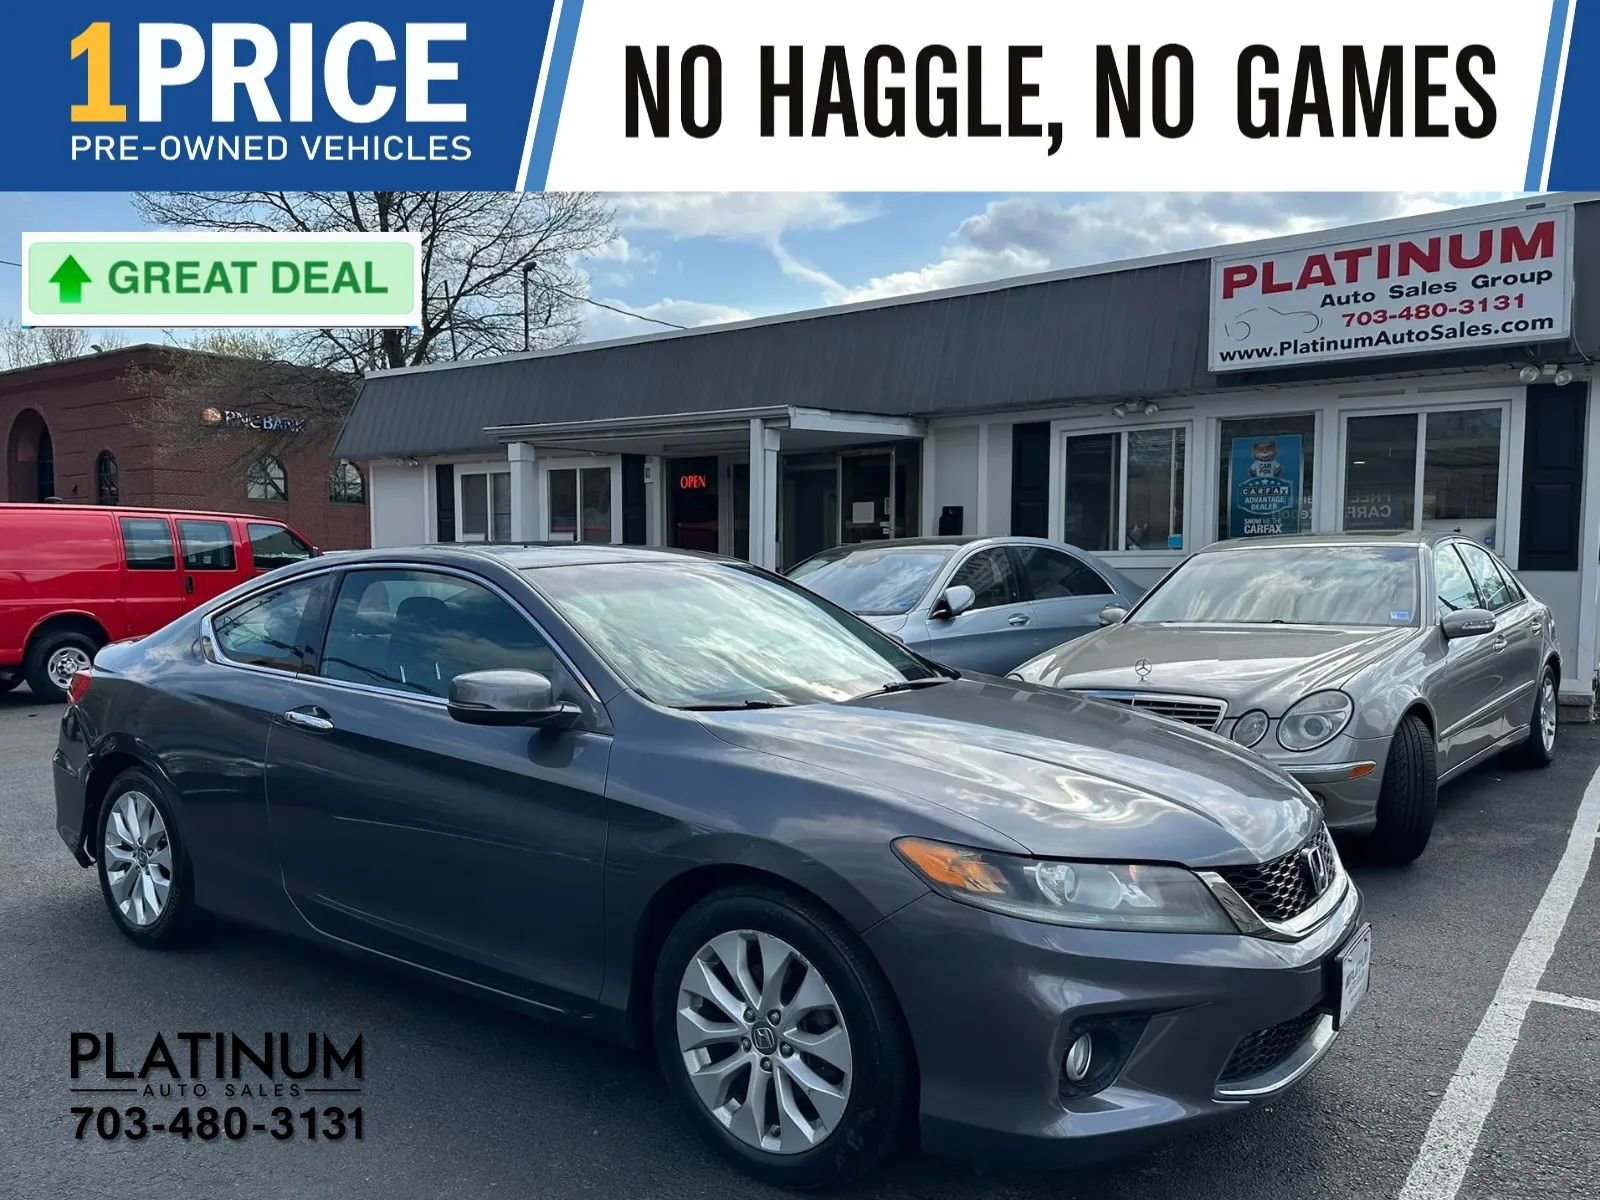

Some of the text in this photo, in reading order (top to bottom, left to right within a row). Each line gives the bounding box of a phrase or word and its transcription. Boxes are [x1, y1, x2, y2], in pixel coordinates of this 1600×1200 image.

[1222, 220, 1556, 300] PLATINUM
[1320, 268, 1553, 308] Auto Sales Group
[1342, 292, 1526, 328] 703-480-3131
[1219, 315, 1555, 363] www.PlatinumAutoSales.com
[680, 474, 706, 489] OPEN
[1241, 487, 1289, 496] CARFAX
[1244, 496, 1286, 504] ADVANTAGE
[1250, 503, 1278, 511] DEALER
[1243, 524, 1282, 534] CARFAX
